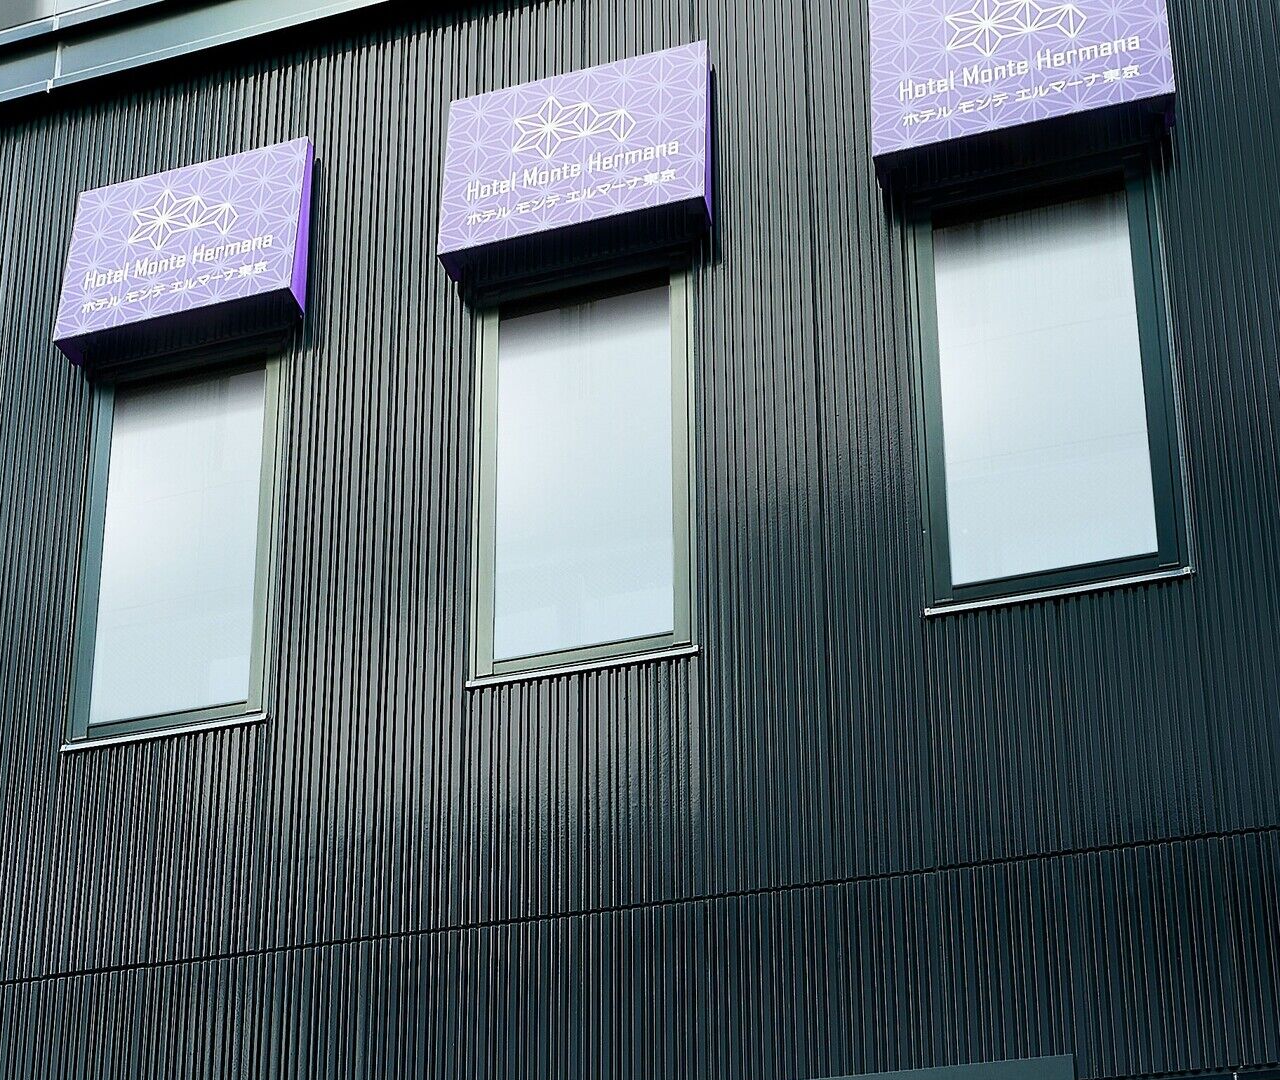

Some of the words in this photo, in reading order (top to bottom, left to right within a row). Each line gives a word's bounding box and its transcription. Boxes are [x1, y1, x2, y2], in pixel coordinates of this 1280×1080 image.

[899, 69, 955, 102] Hotel
[962, 59, 1029, 86] Monte
[1036, 35, 1141, 71] Hermana
[903, 105, 953, 127] ホテル
[958, 92, 1009, 114] モンテ
[1015, 64, 1141, 104] エルマーナ東京
[466, 171, 517, 202] Hotel
[522, 161, 582, 188] Monte
[588, 140, 680, 173] Hermana
[466, 206, 510, 226] ホテル
[516, 193, 562, 214] モンテ
[565, 168, 677, 204] エルマーナ東京
[81, 295, 120, 314] ホテル
[125, 284, 167, 303] モンテ
[169, 260, 268, 293] エルマーナ東京
[83, 261, 129, 291] Hotel
[133, 253, 186, 279] Monte
[191, 233, 274, 264] Hermana
